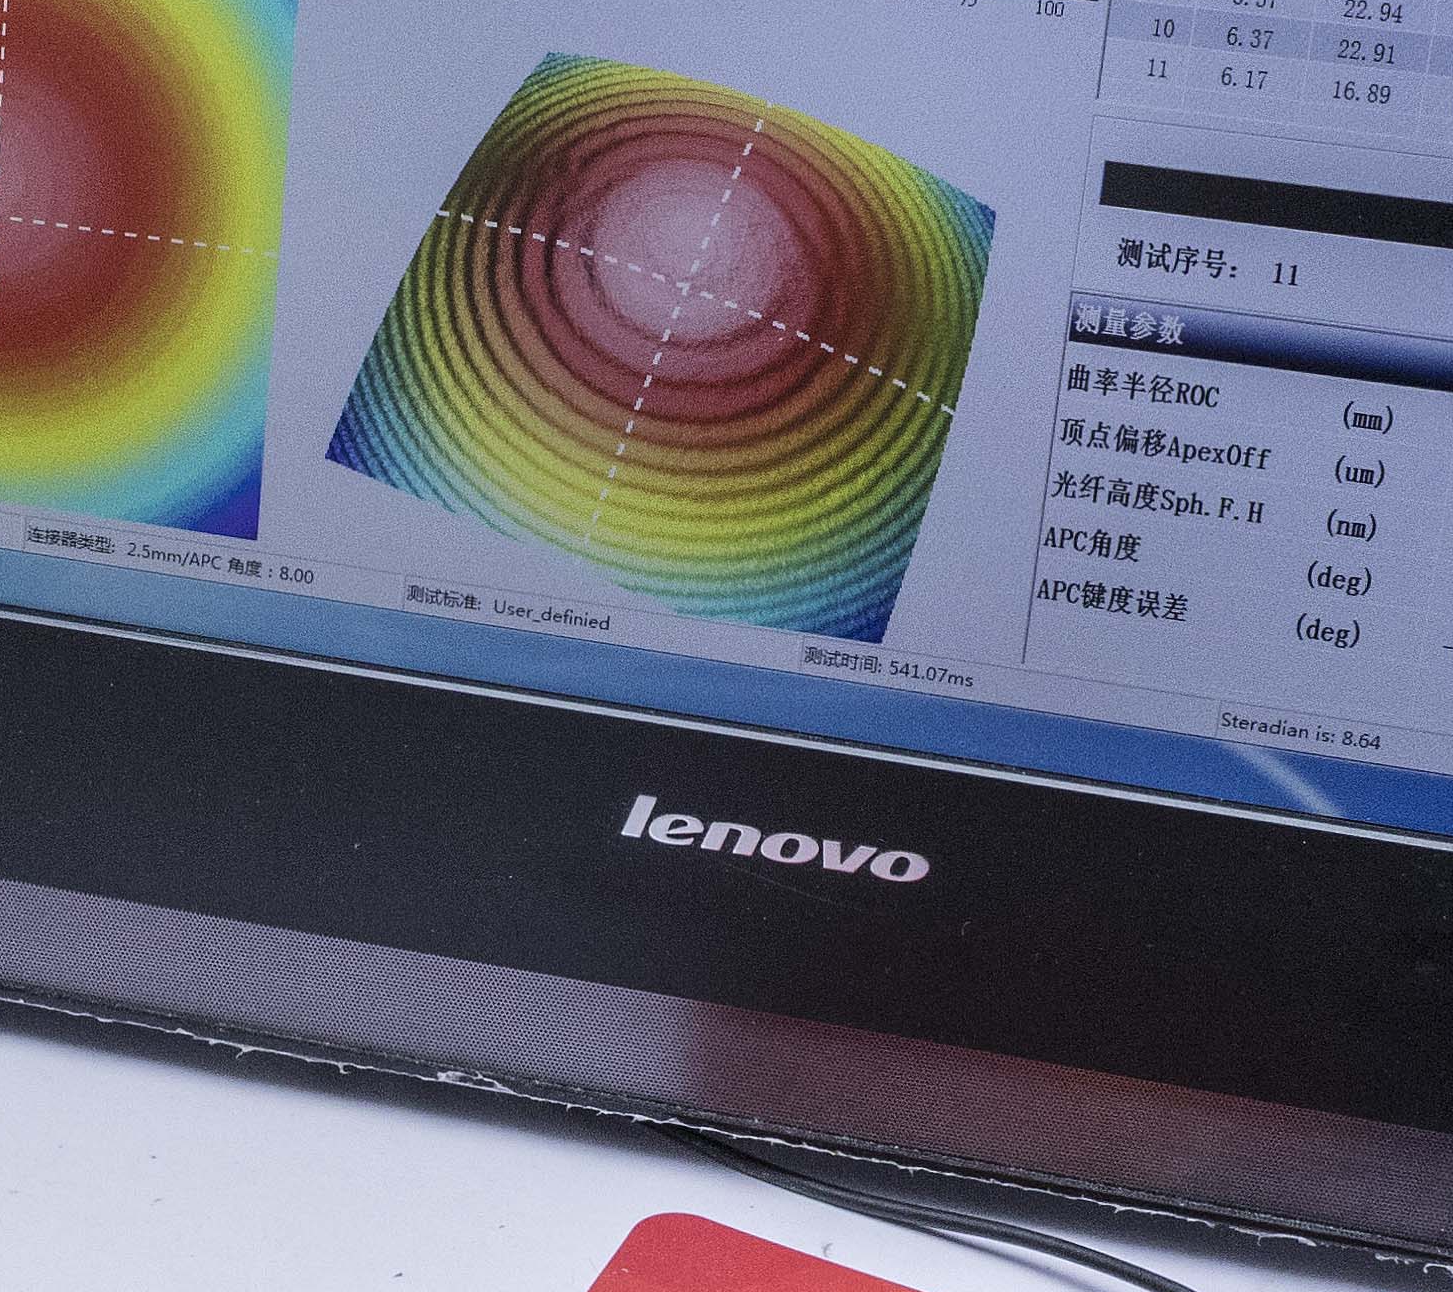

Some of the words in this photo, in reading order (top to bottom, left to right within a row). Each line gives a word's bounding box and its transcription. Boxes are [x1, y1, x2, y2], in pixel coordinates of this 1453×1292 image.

[1154, 19, 1175, 38] 10
[1227, 26, 1274, 49] 6.37
[1337, 39, 1394, 64] 22.91
[1148, 59, 1166, 78] 11
[1221, 67, 1268, 89] 6.17
[1333, 81, 1391, 104] 16.89
[1274, 263, 1297, 285] 11
[1075, 305, 1184, 346] 测量参数
[1068, 364, 1219, 407] 曲率半径ROC
[1344, 401, 1393, 434] (mm)
[1061, 419, 1271, 469] 顶点偏移ApexOff
[1335, 456, 1385, 488] (um)
[1052, 471, 1264, 523] 光纤高度Sph.F.H
[1327, 509, 1376, 541] (nm)
[127, 542, 221, 570] 2.5mm/APC
[1043, 525, 1142, 565] APC角度
[1308, 561, 1371, 596] (deg)
[494, 600, 610, 630] User_definied
[1037, 579, 1188, 621] APC键度误差
[1296, 613, 1360, 648] (deg)
[890, 661, 973, 687] 541.07ms
[1222, 712, 1308, 738] Steradian
[1316, 725, 1335, 744] is:
[1342, 731, 1380, 749] 8.64
[621, 795, 929, 881] lenovo
